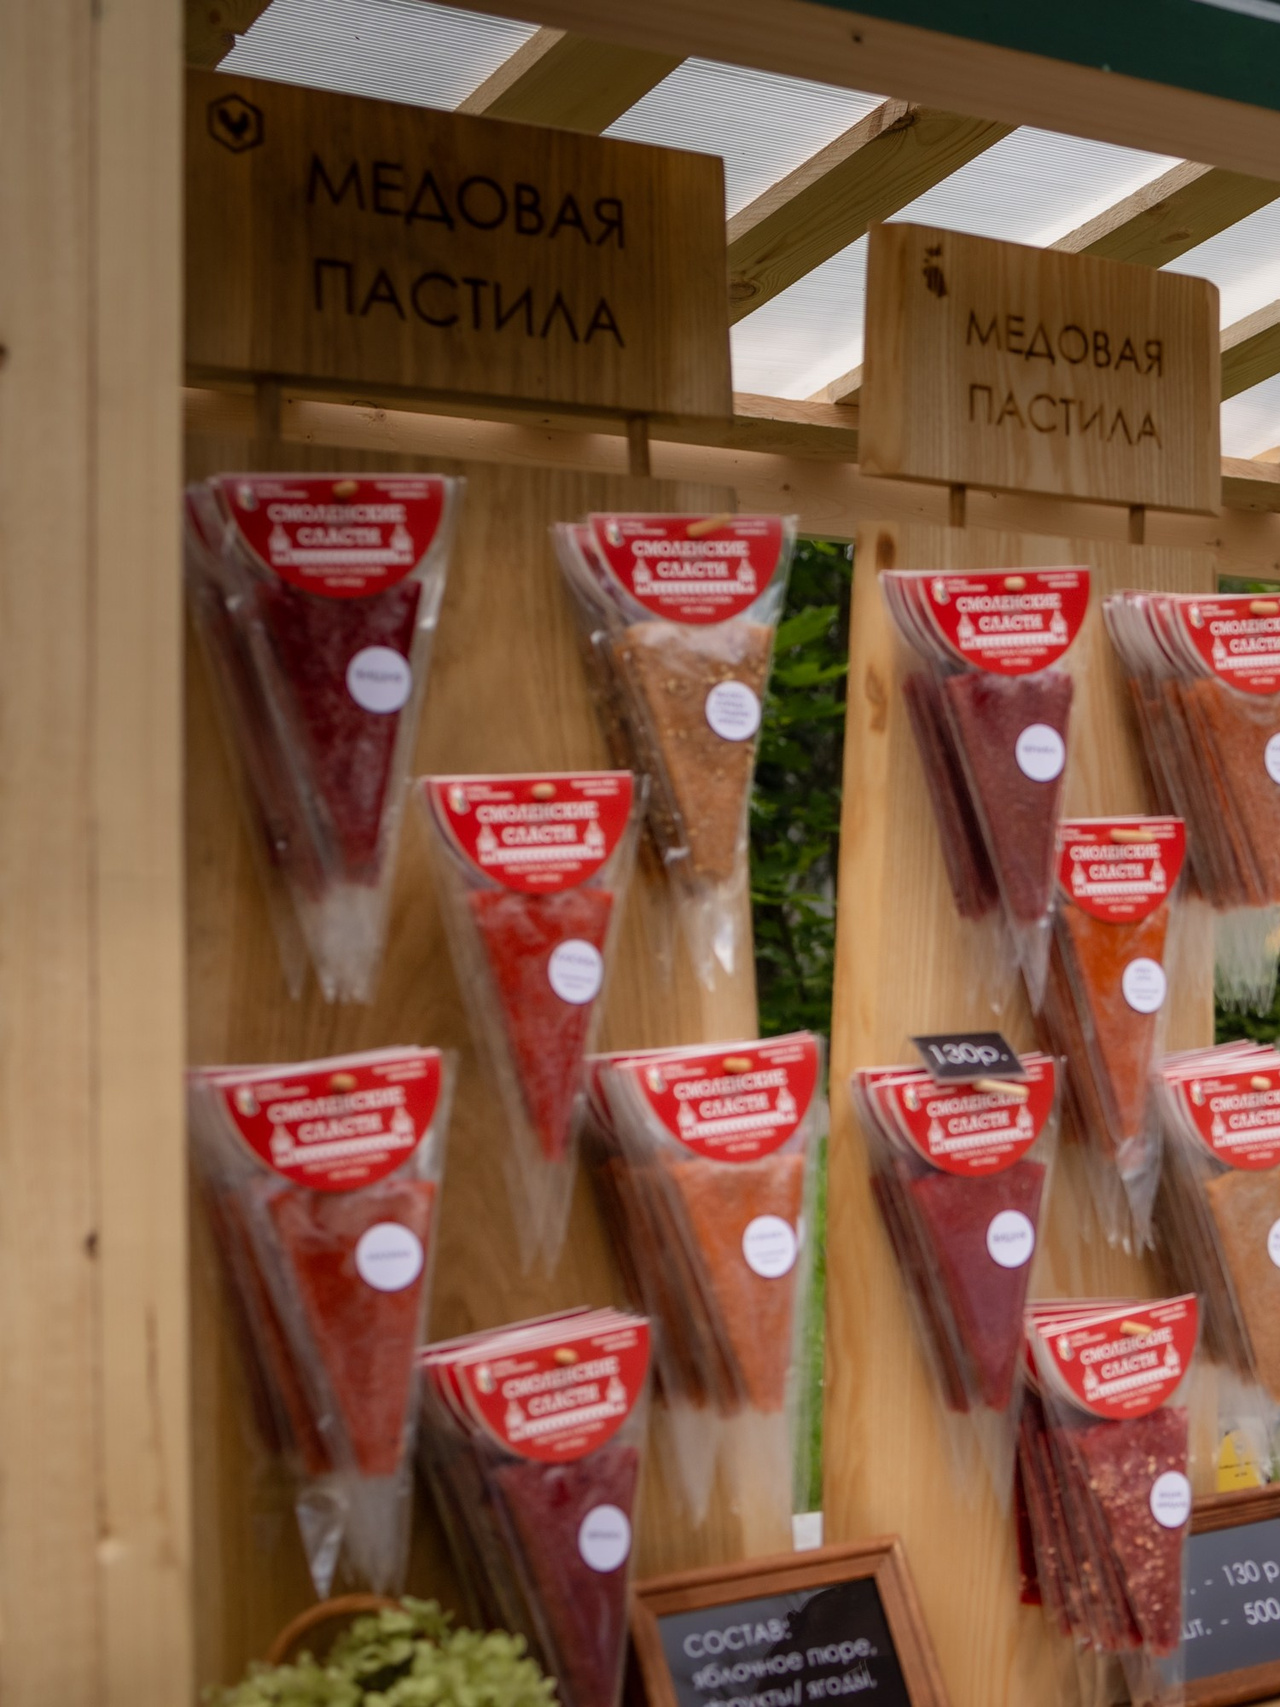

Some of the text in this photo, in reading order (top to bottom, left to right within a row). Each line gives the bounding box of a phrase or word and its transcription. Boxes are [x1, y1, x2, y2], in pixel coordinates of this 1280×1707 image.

[308, 153, 626, 250] МЕДОВАЯ
[313, 258, 626, 348] ПАСТИЛА
[966, 308, 1163, 378] МЕДОВАЯ
[969, 383, 1163, 450] ПАСТИЛА
[656, 561, 729, 578] СЛАСТИ
[978, 614, 1043, 632] СЛАСТИ
[1089, 863, 1145, 880] СЛАСТИ
[1222, 1559, 1260, 1587] 130
[683, 1617, 793, 1659] СОСТАВ:
[691, 1650, 805, 1691] яблочное
